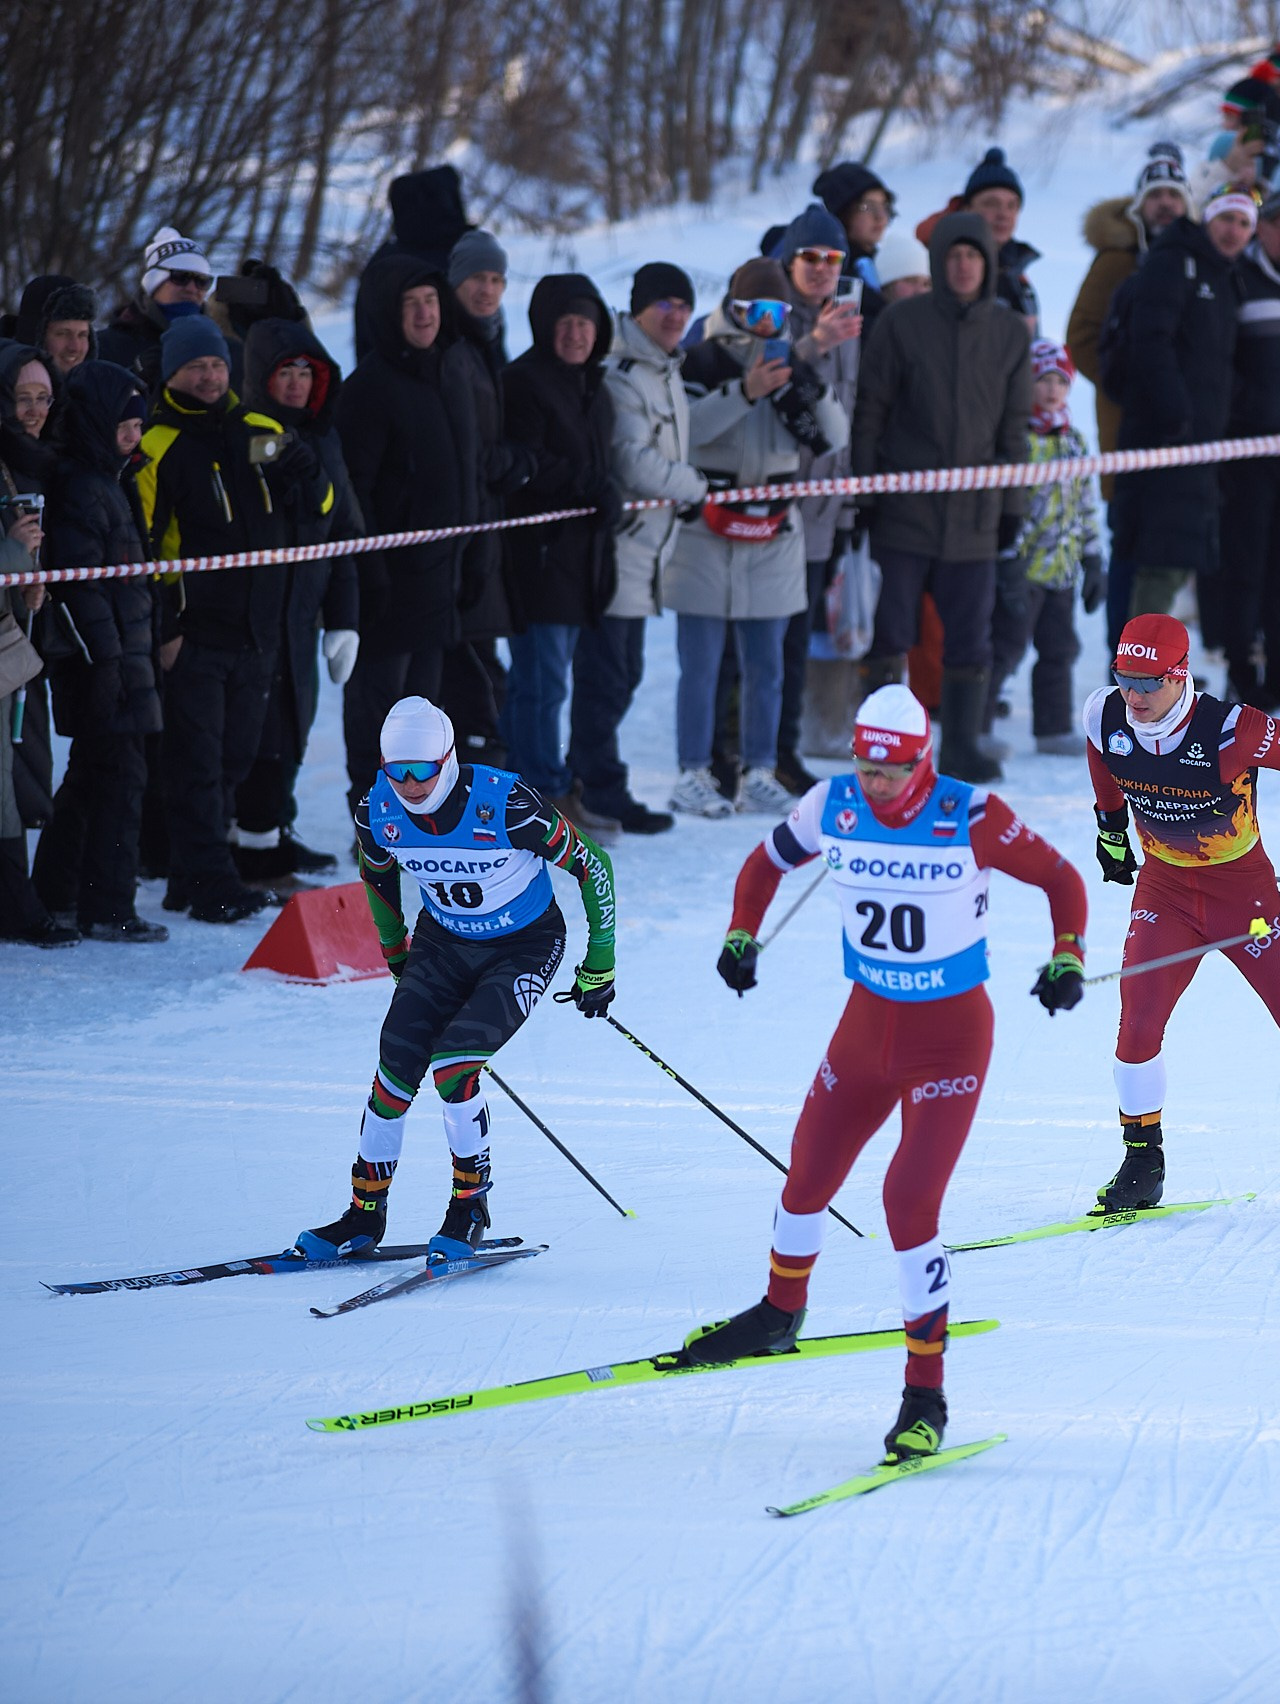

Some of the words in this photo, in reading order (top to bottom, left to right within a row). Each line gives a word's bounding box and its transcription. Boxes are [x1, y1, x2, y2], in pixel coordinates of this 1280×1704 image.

[862, 729, 902, 747] LUKOIL
[1179, 758, 1212, 768] ФОСАГРО
[1162, 786, 1213, 798] СТРАНА
[405, 858, 509, 874] ФОСАГРО
[849, 858, 963, 880] ФОСАГРО
[428, 882, 484, 909] 10
[856, 900, 926, 953] 20
[911, 1074, 979, 1105] BOSCO
[1102, 1211, 1138, 1226] FISCHER
[925, 1256, 949, 1294] 2
[360, 1394, 475, 1426] FISCHER
